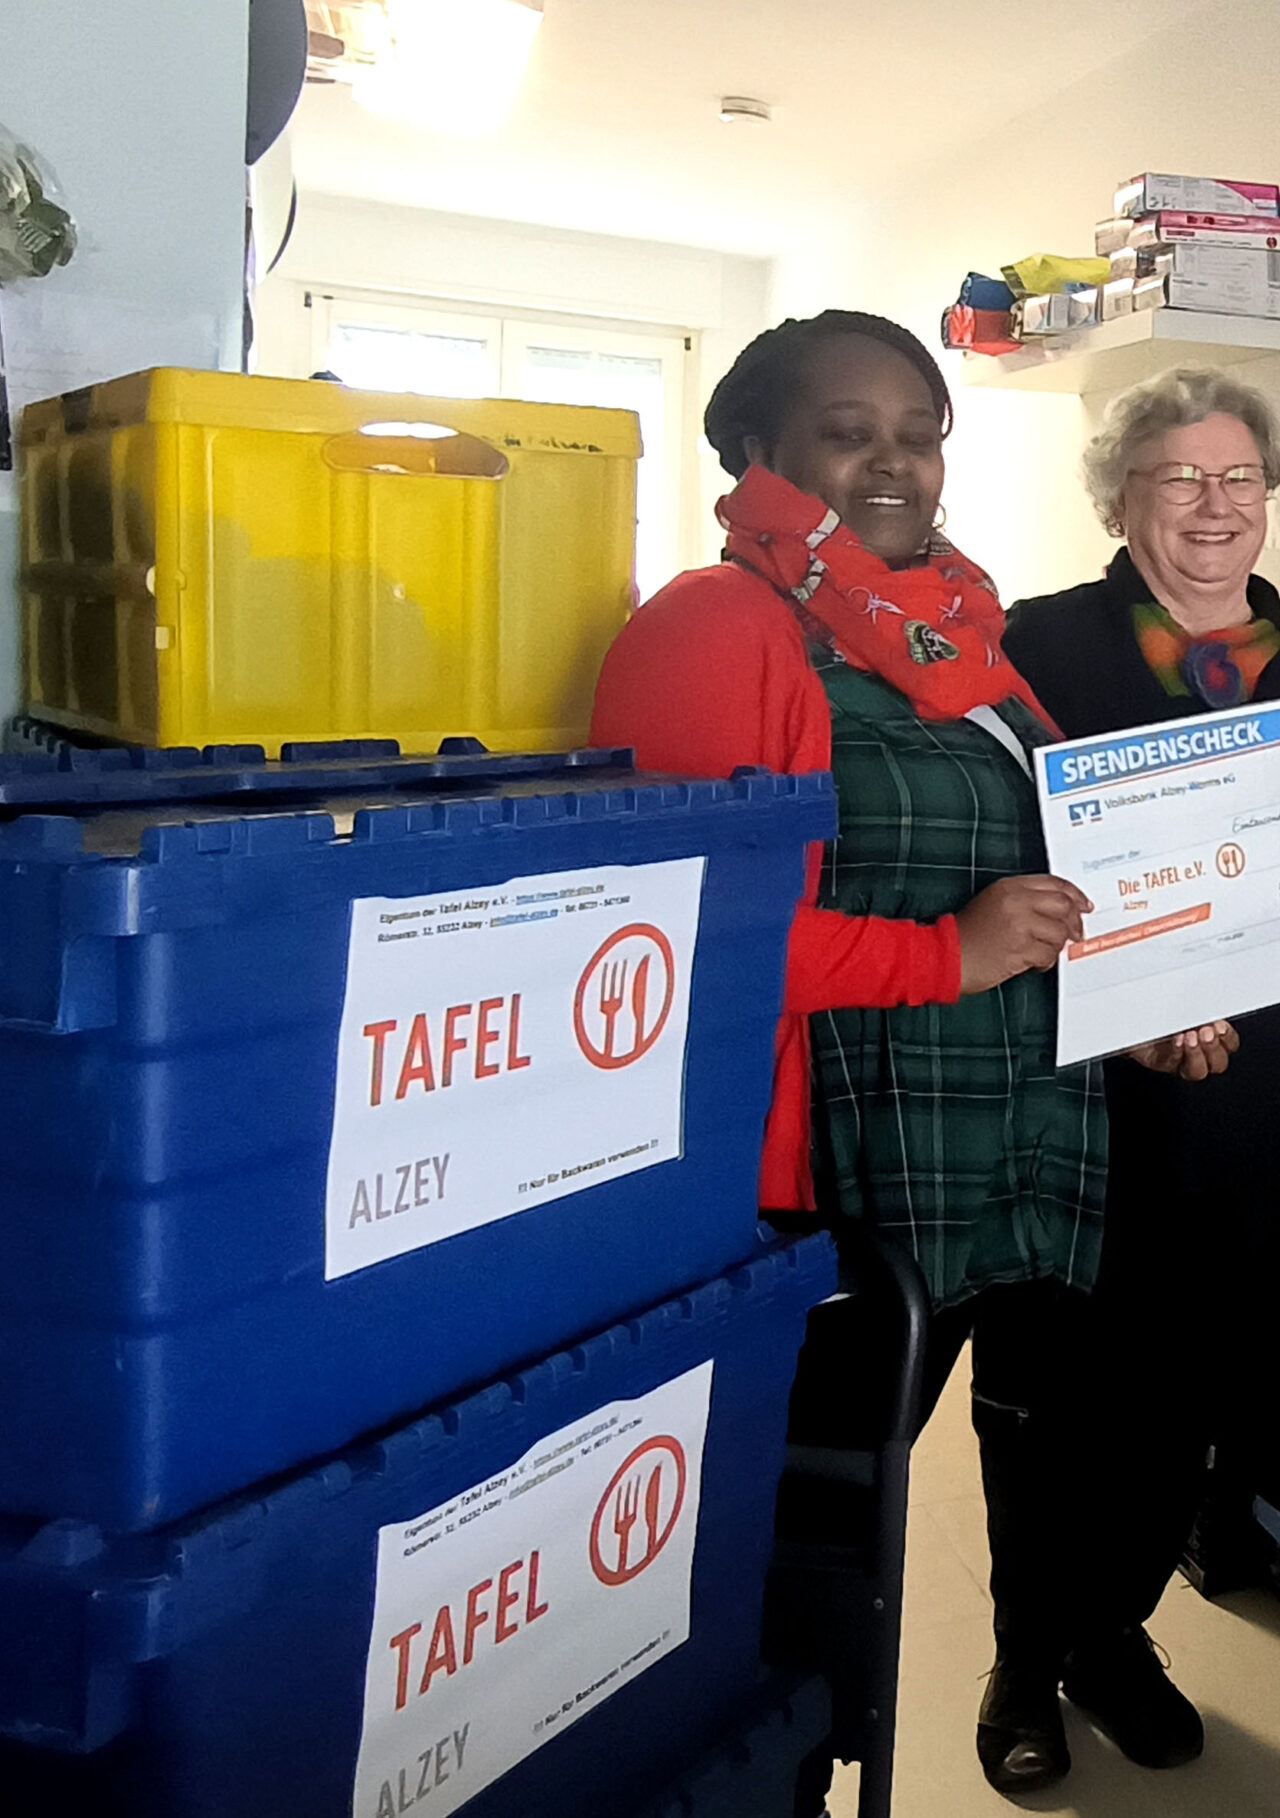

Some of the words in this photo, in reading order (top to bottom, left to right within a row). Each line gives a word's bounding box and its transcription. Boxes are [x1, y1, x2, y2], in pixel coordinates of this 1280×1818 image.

[1061, 720, 1264, 784] SPENDENSCHECK
[1104, 791, 1158, 810] Volksbank
[439, 902, 463, 915] Tafel
[463, 899, 490, 911] Alzey
[1117, 878, 1142, 897] Die
[1143, 866, 1182, 890] TAFEL
[1184, 860, 1207, 881] e.V.
[362, 992, 532, 1108] TAFEL
[347, 1152, 451, 1229] ALZEY
[460, 1487, 483, 1507] Tafel
[484, 1475, 508, 1495] Alzey
[389, 1549, 549, 1712] TAFEL
[376, 1721, 470, 1818] ALZEY
